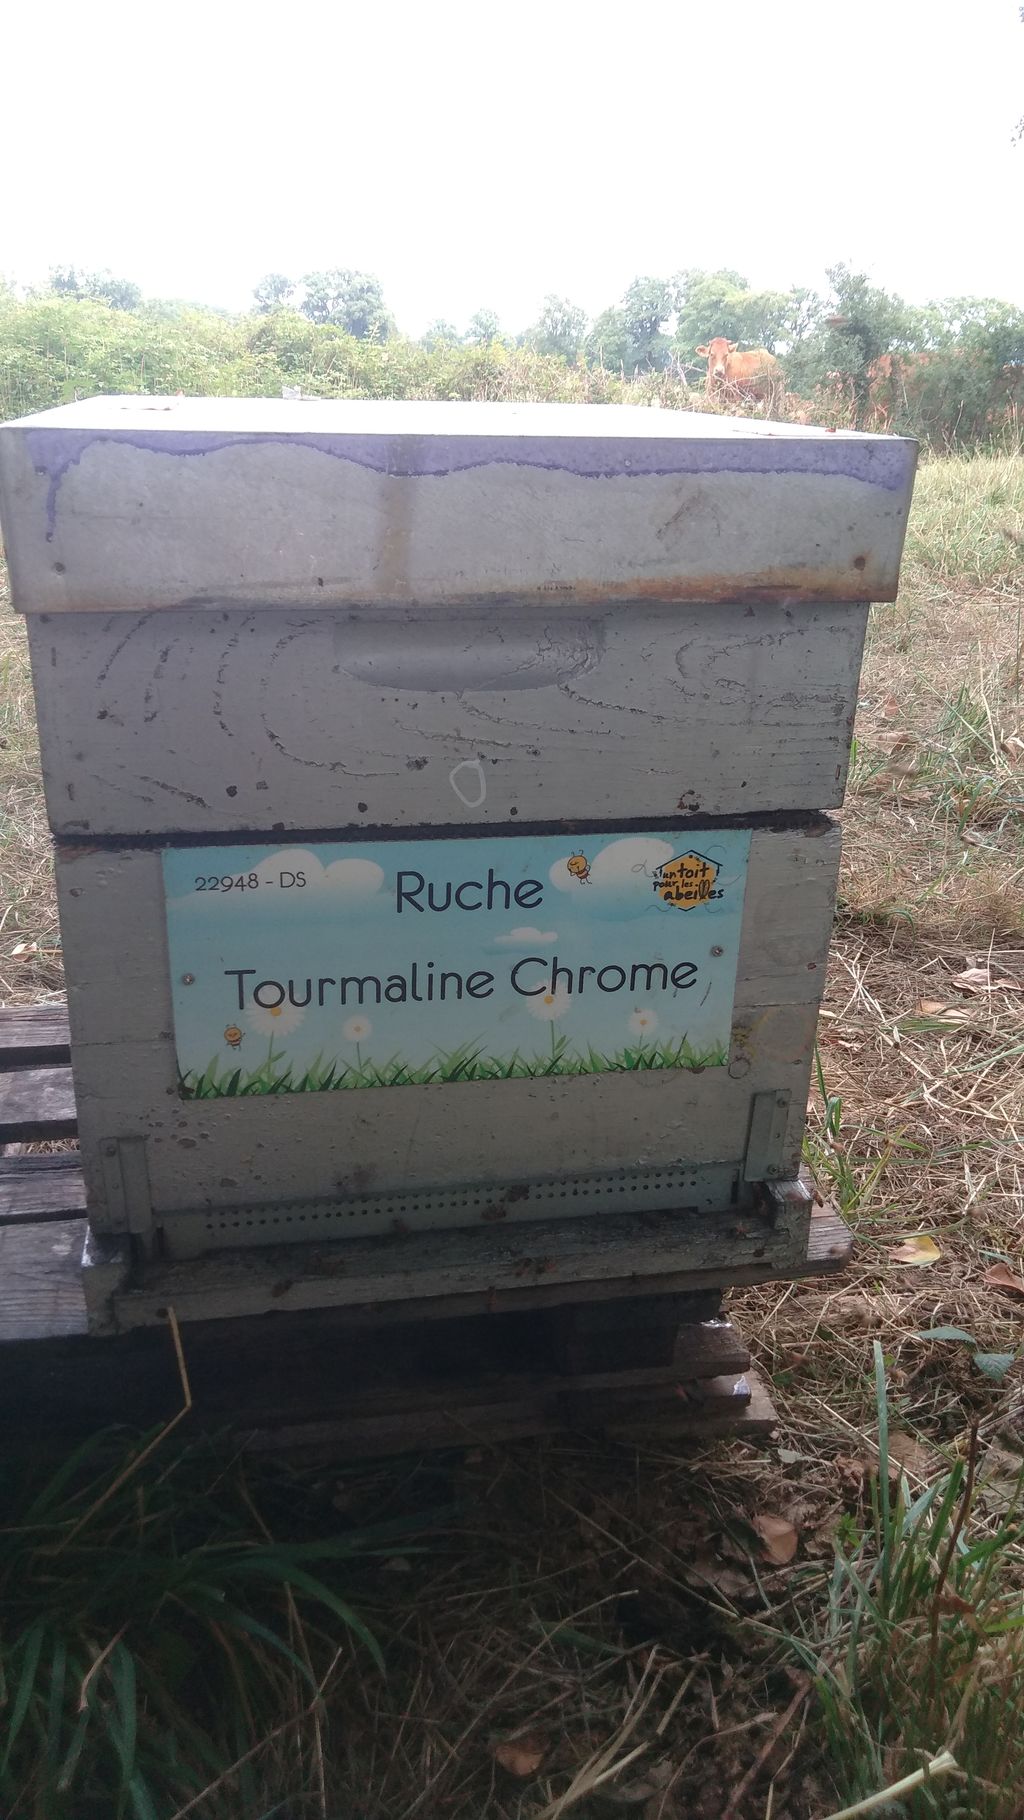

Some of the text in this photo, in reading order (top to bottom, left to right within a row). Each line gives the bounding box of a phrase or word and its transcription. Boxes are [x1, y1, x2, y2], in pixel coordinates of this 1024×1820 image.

[662, 862, 709, 879] un toit
[194, 873, 259, 892] 22948
[280, 871, 307, 889] DS
[396, 868, 544, 914] Ruche
[653, 879, 693, 892] pour les
[664, 879, 724, 901] abeilles
[224, 956, 698, 1010] Tourmaline Chrome
